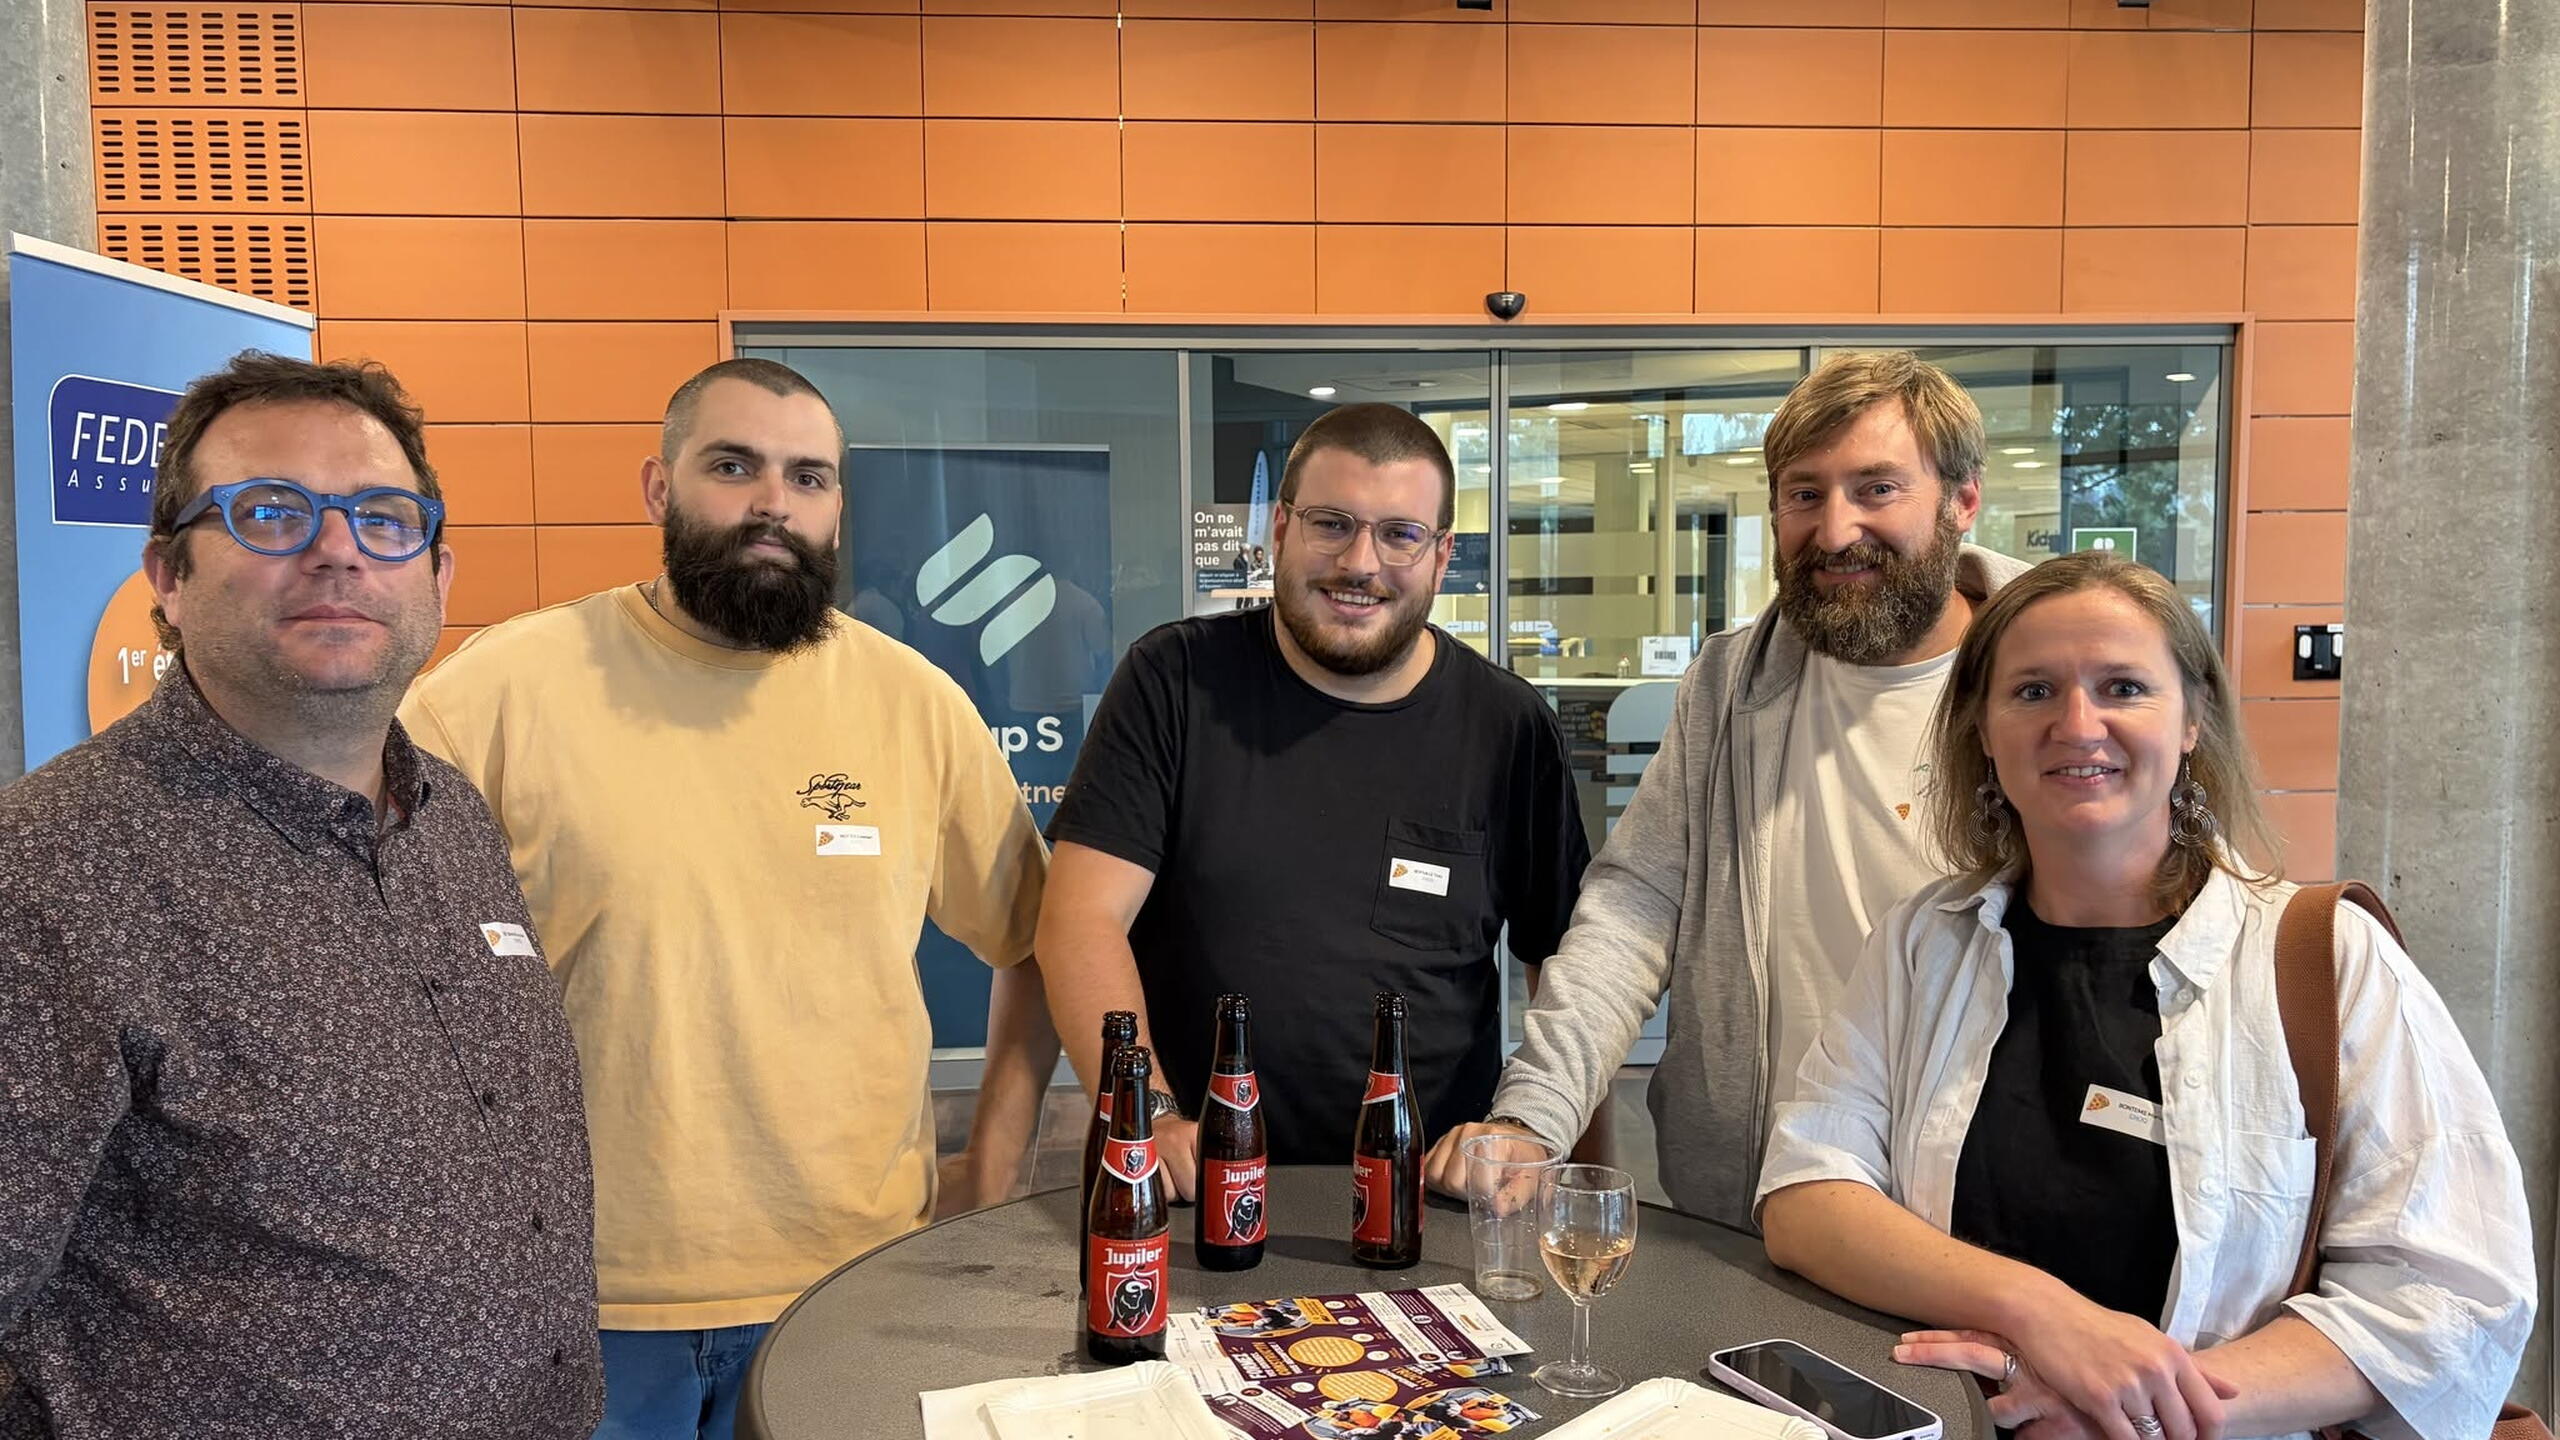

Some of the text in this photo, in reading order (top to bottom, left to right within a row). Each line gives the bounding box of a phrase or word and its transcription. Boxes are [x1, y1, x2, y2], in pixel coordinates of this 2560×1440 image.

[67, 469, 151, 493] Assu
[1195, 511, 1235, 524] On ne
[1195, 526, 1243, 538] m'avait
[1195, 540, 1240, 554] pas dit
[1195, 556, 1220, 568] que
[1036, 716, 1064, 752] S
[1102, 1247, 1163, 1270] Jupiler
